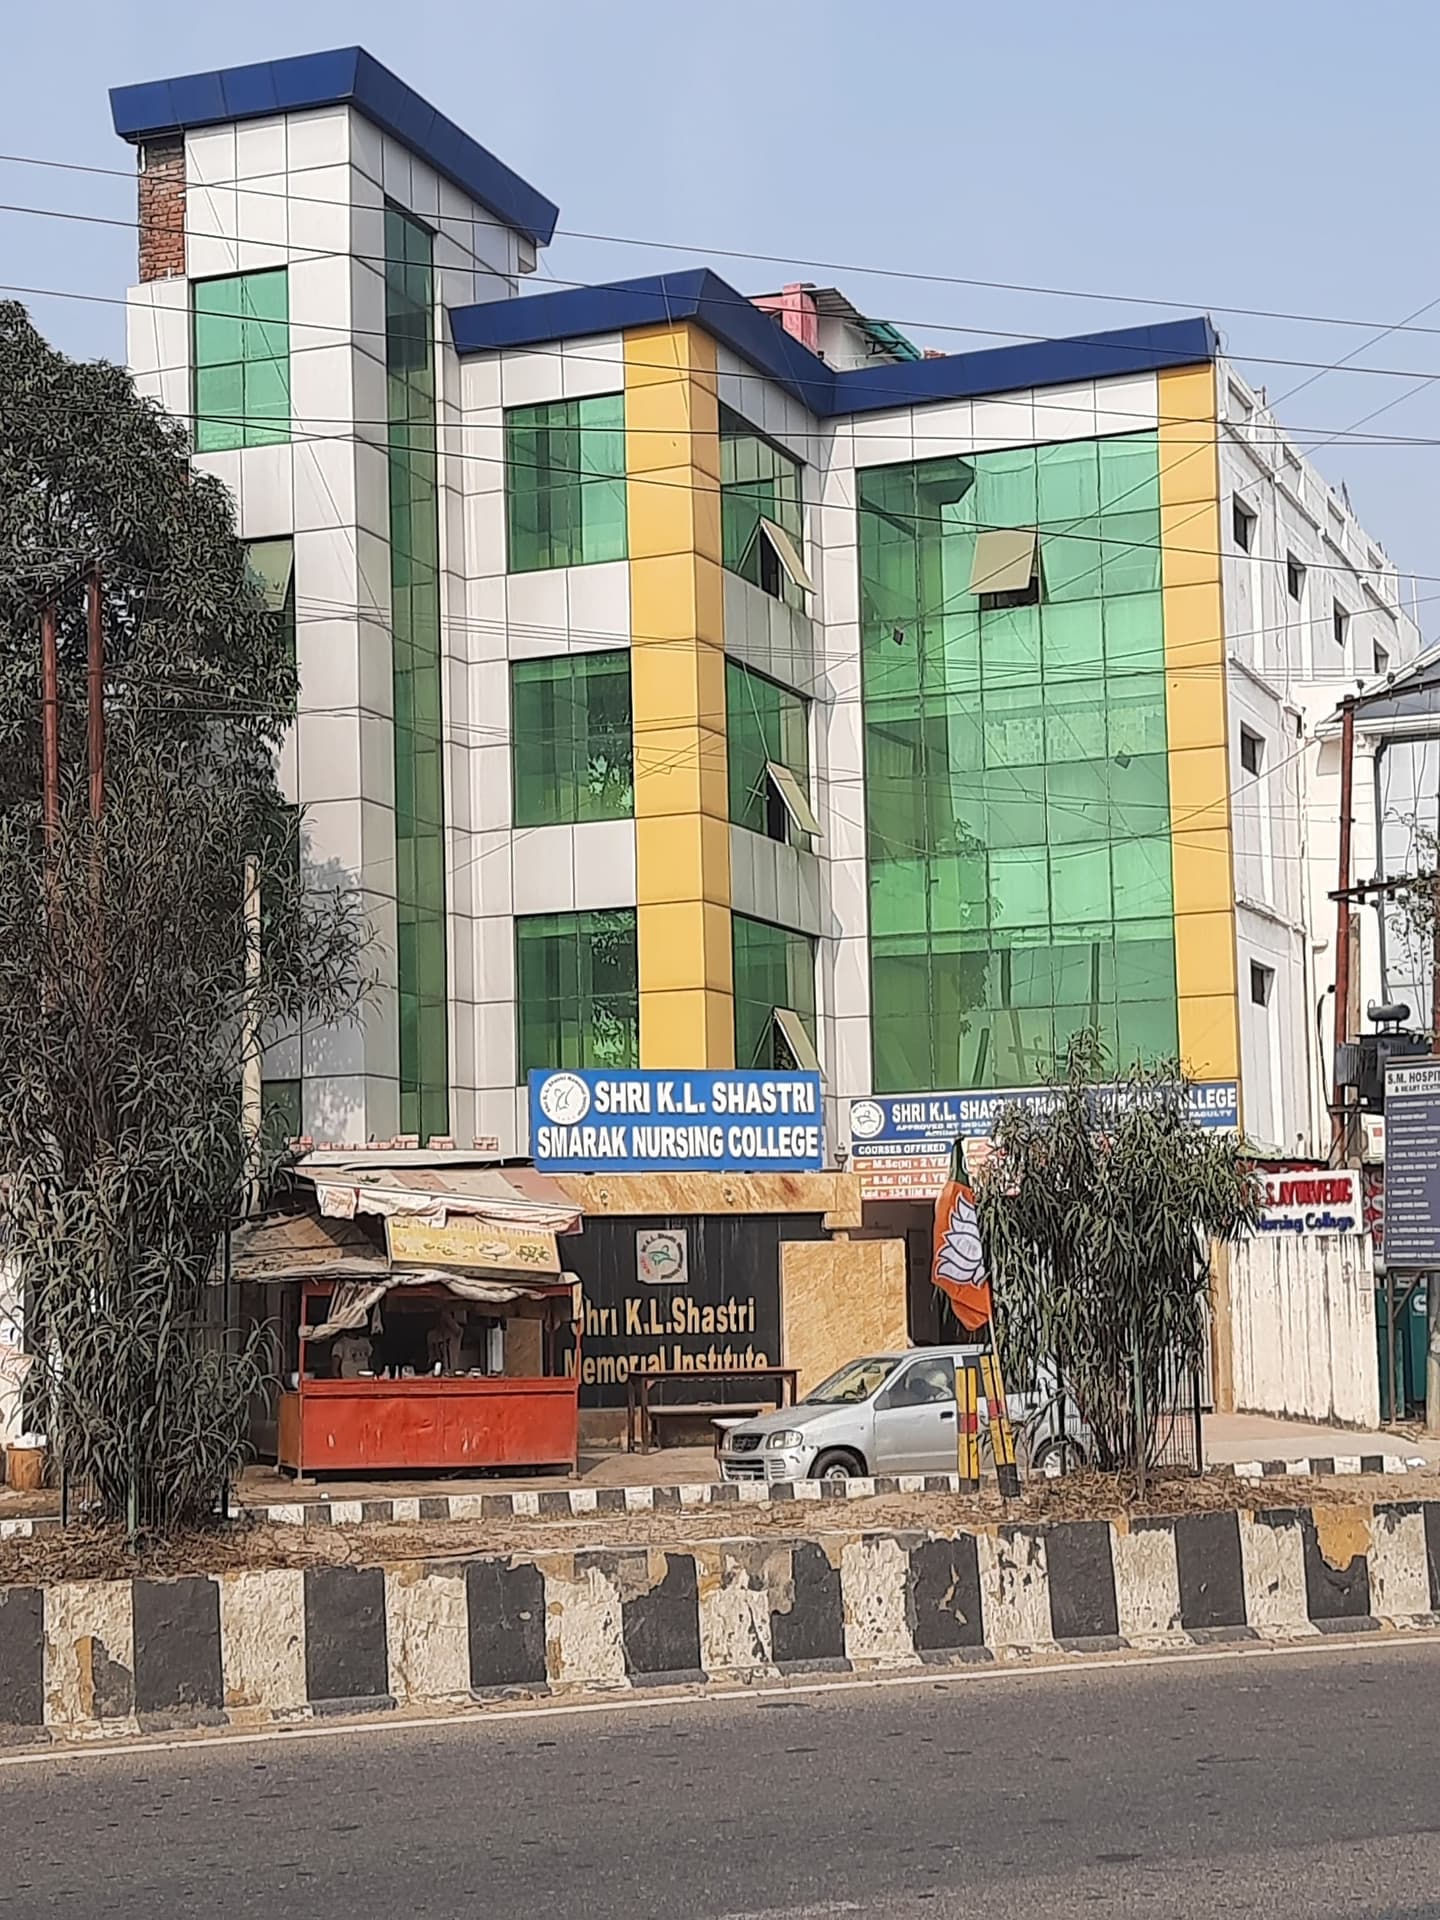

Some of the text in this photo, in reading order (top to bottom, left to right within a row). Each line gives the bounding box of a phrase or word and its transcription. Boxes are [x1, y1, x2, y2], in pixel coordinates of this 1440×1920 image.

[595, 1082, 814, 1113] SHRI K.L. SHASTRI
[892, 1104, 925, 1122] SHRI
[929, 1102, 956, 1120] K.L.
[537, 1125, 819, 1159] SMARAK NURSING COLLEGE
[858, 1143, 946, 1156] COURSES OFFERED
